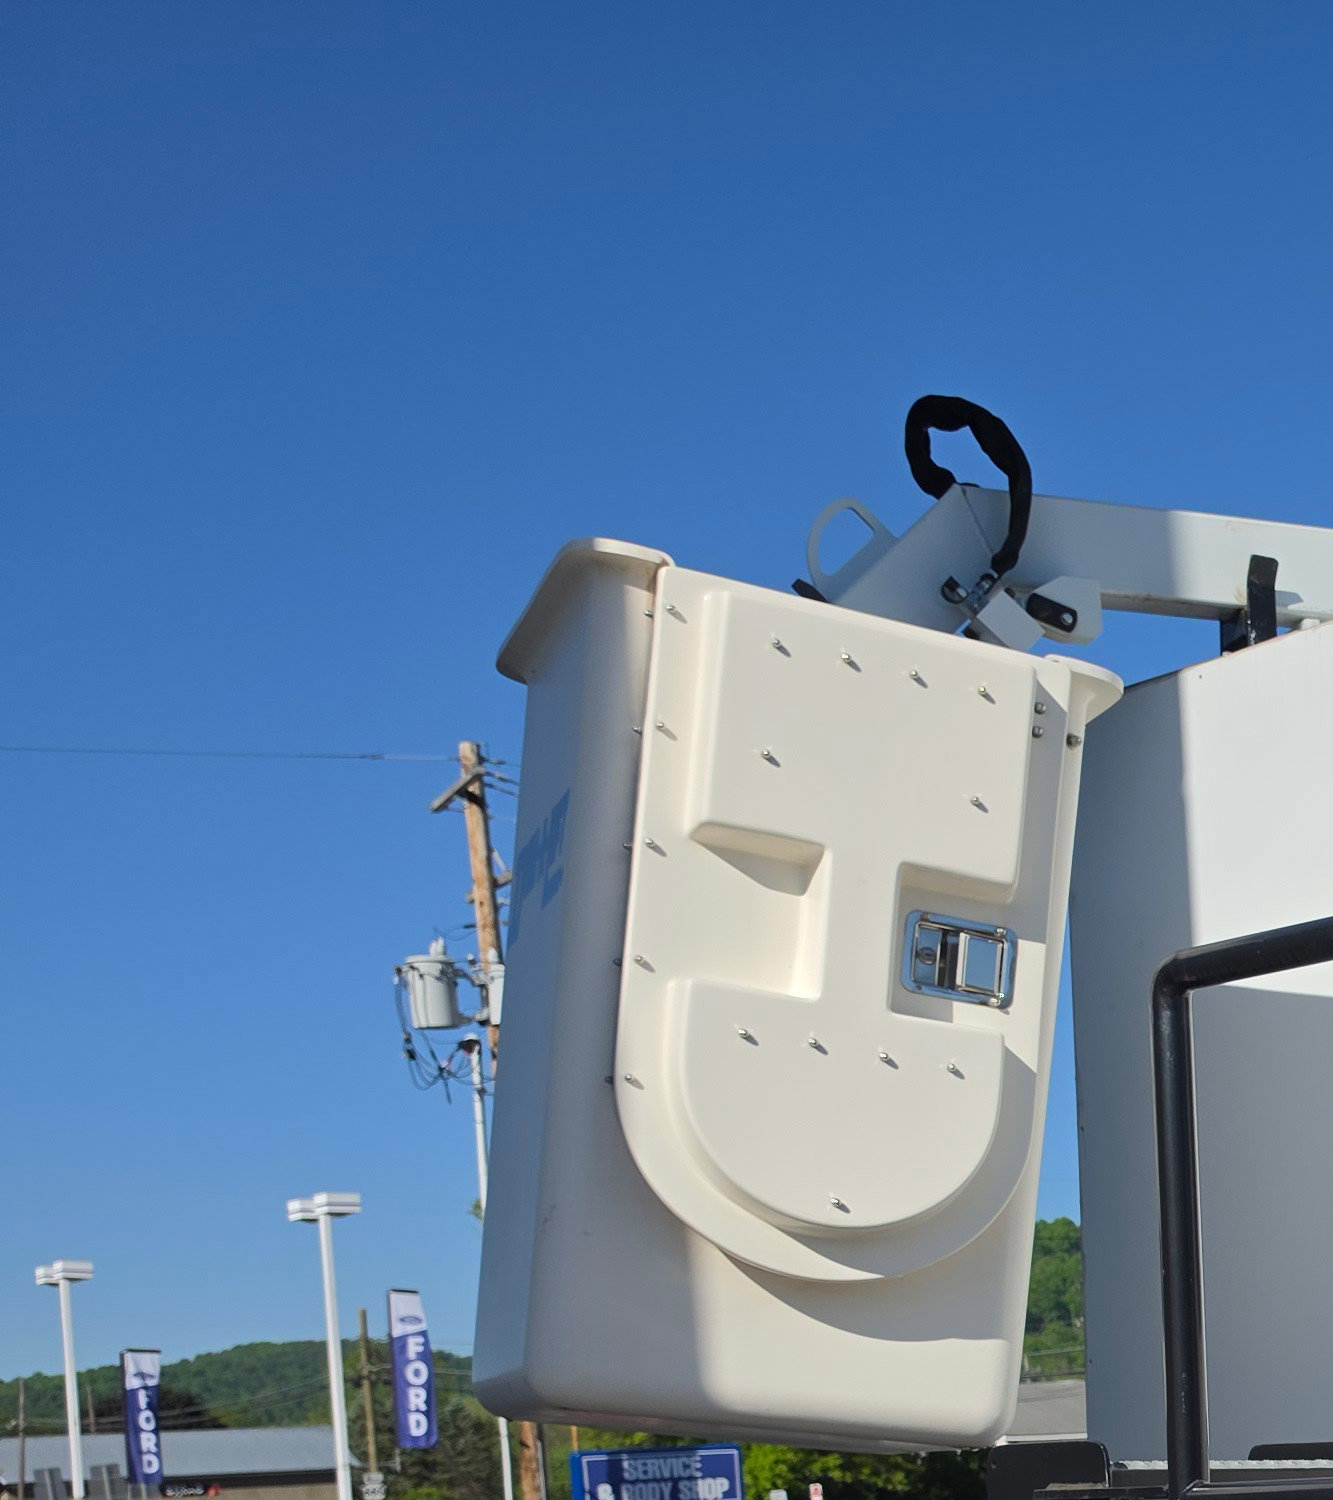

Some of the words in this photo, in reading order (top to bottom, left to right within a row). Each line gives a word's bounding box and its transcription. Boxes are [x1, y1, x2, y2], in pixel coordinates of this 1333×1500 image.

[404, 1335, 429, 1437] FORD
[622, 1457, 702, 1480] SERVICE
[678, 1477, 730, 1500] SHOP
